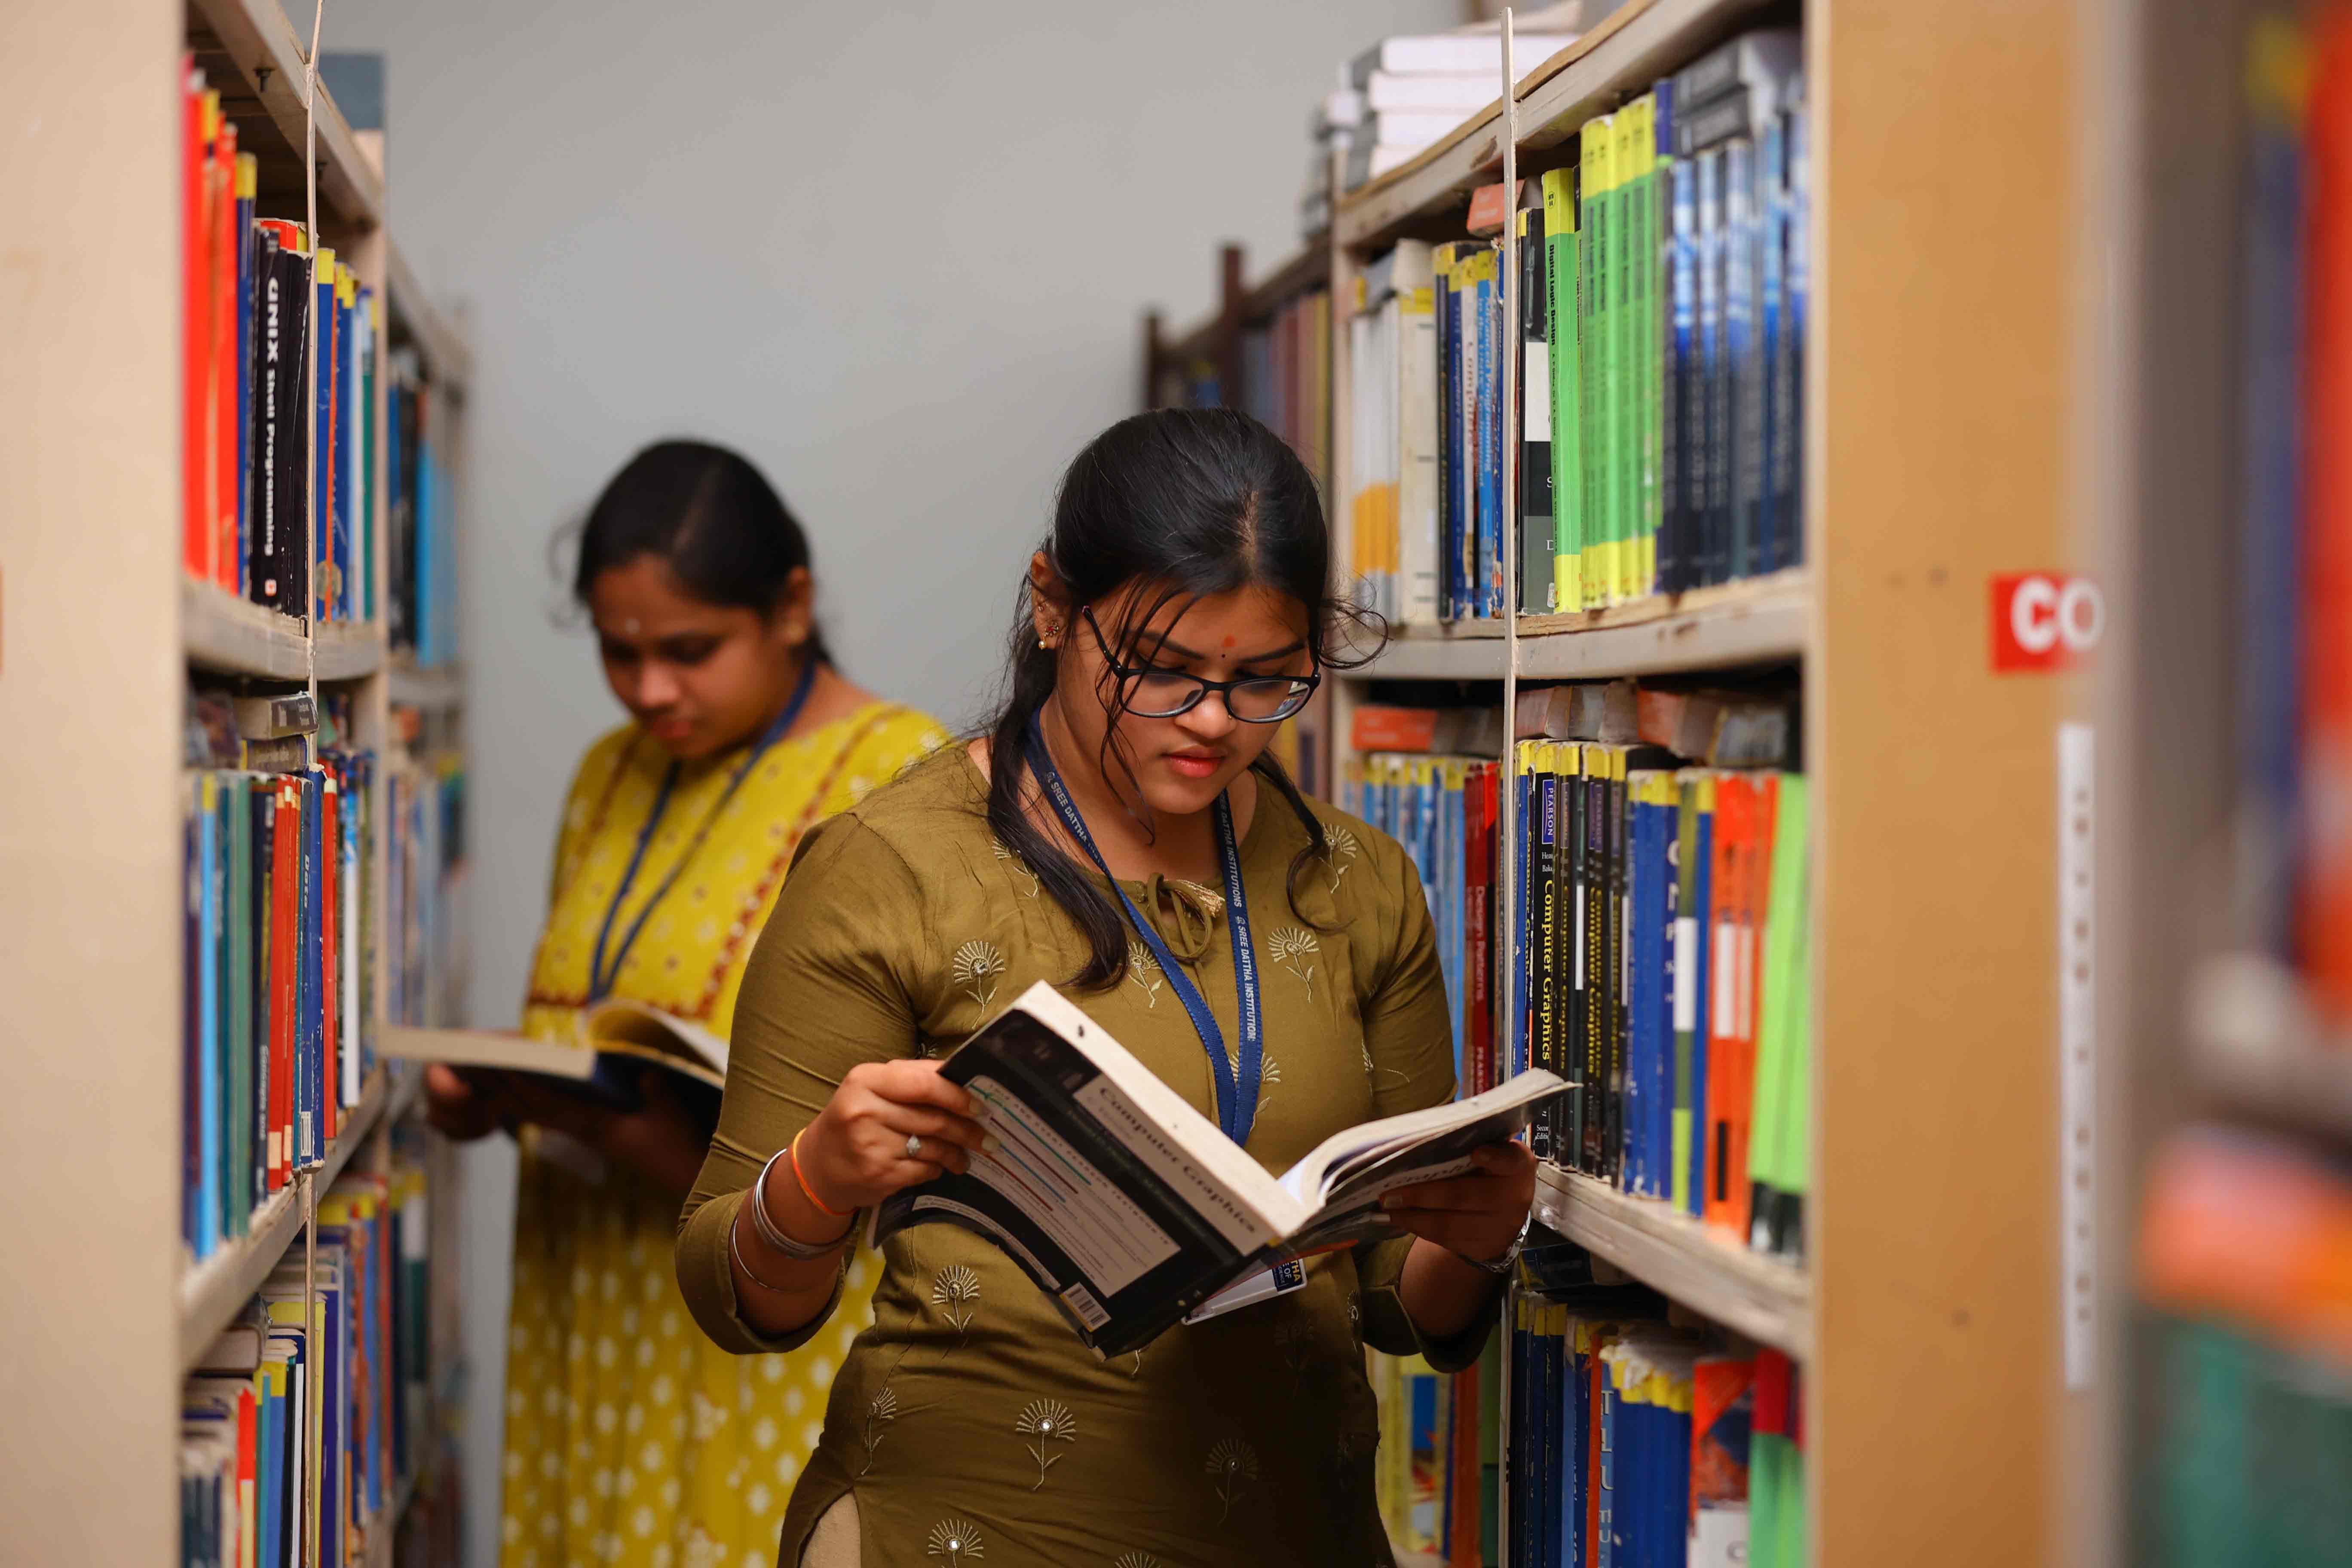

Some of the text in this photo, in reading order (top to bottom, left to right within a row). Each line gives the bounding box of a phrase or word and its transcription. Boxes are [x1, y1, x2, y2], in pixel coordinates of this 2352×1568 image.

[267, 276, 279, 362] UNIX
[264, 423, 276, 556] Programming
[2010, 575, 2107, 653] CO
[1050, 781, 1087, 843] SREE DATTHA
[1227, 846, 1243, 908] INSTITUTIONS
[1238, 925, 1249, 947] SREE
[1474, 885, 1485, 938] Design
[1241, 948, 1253, 981] DATTHA
[1476, 940, 1486, 1001] Patterns
[1540, 880, 1553, 1060] Computer Graphics
[1100, 1086, 1256, 1233] Computer Graphics
[1284, 1268, 1292, 1279] OF
